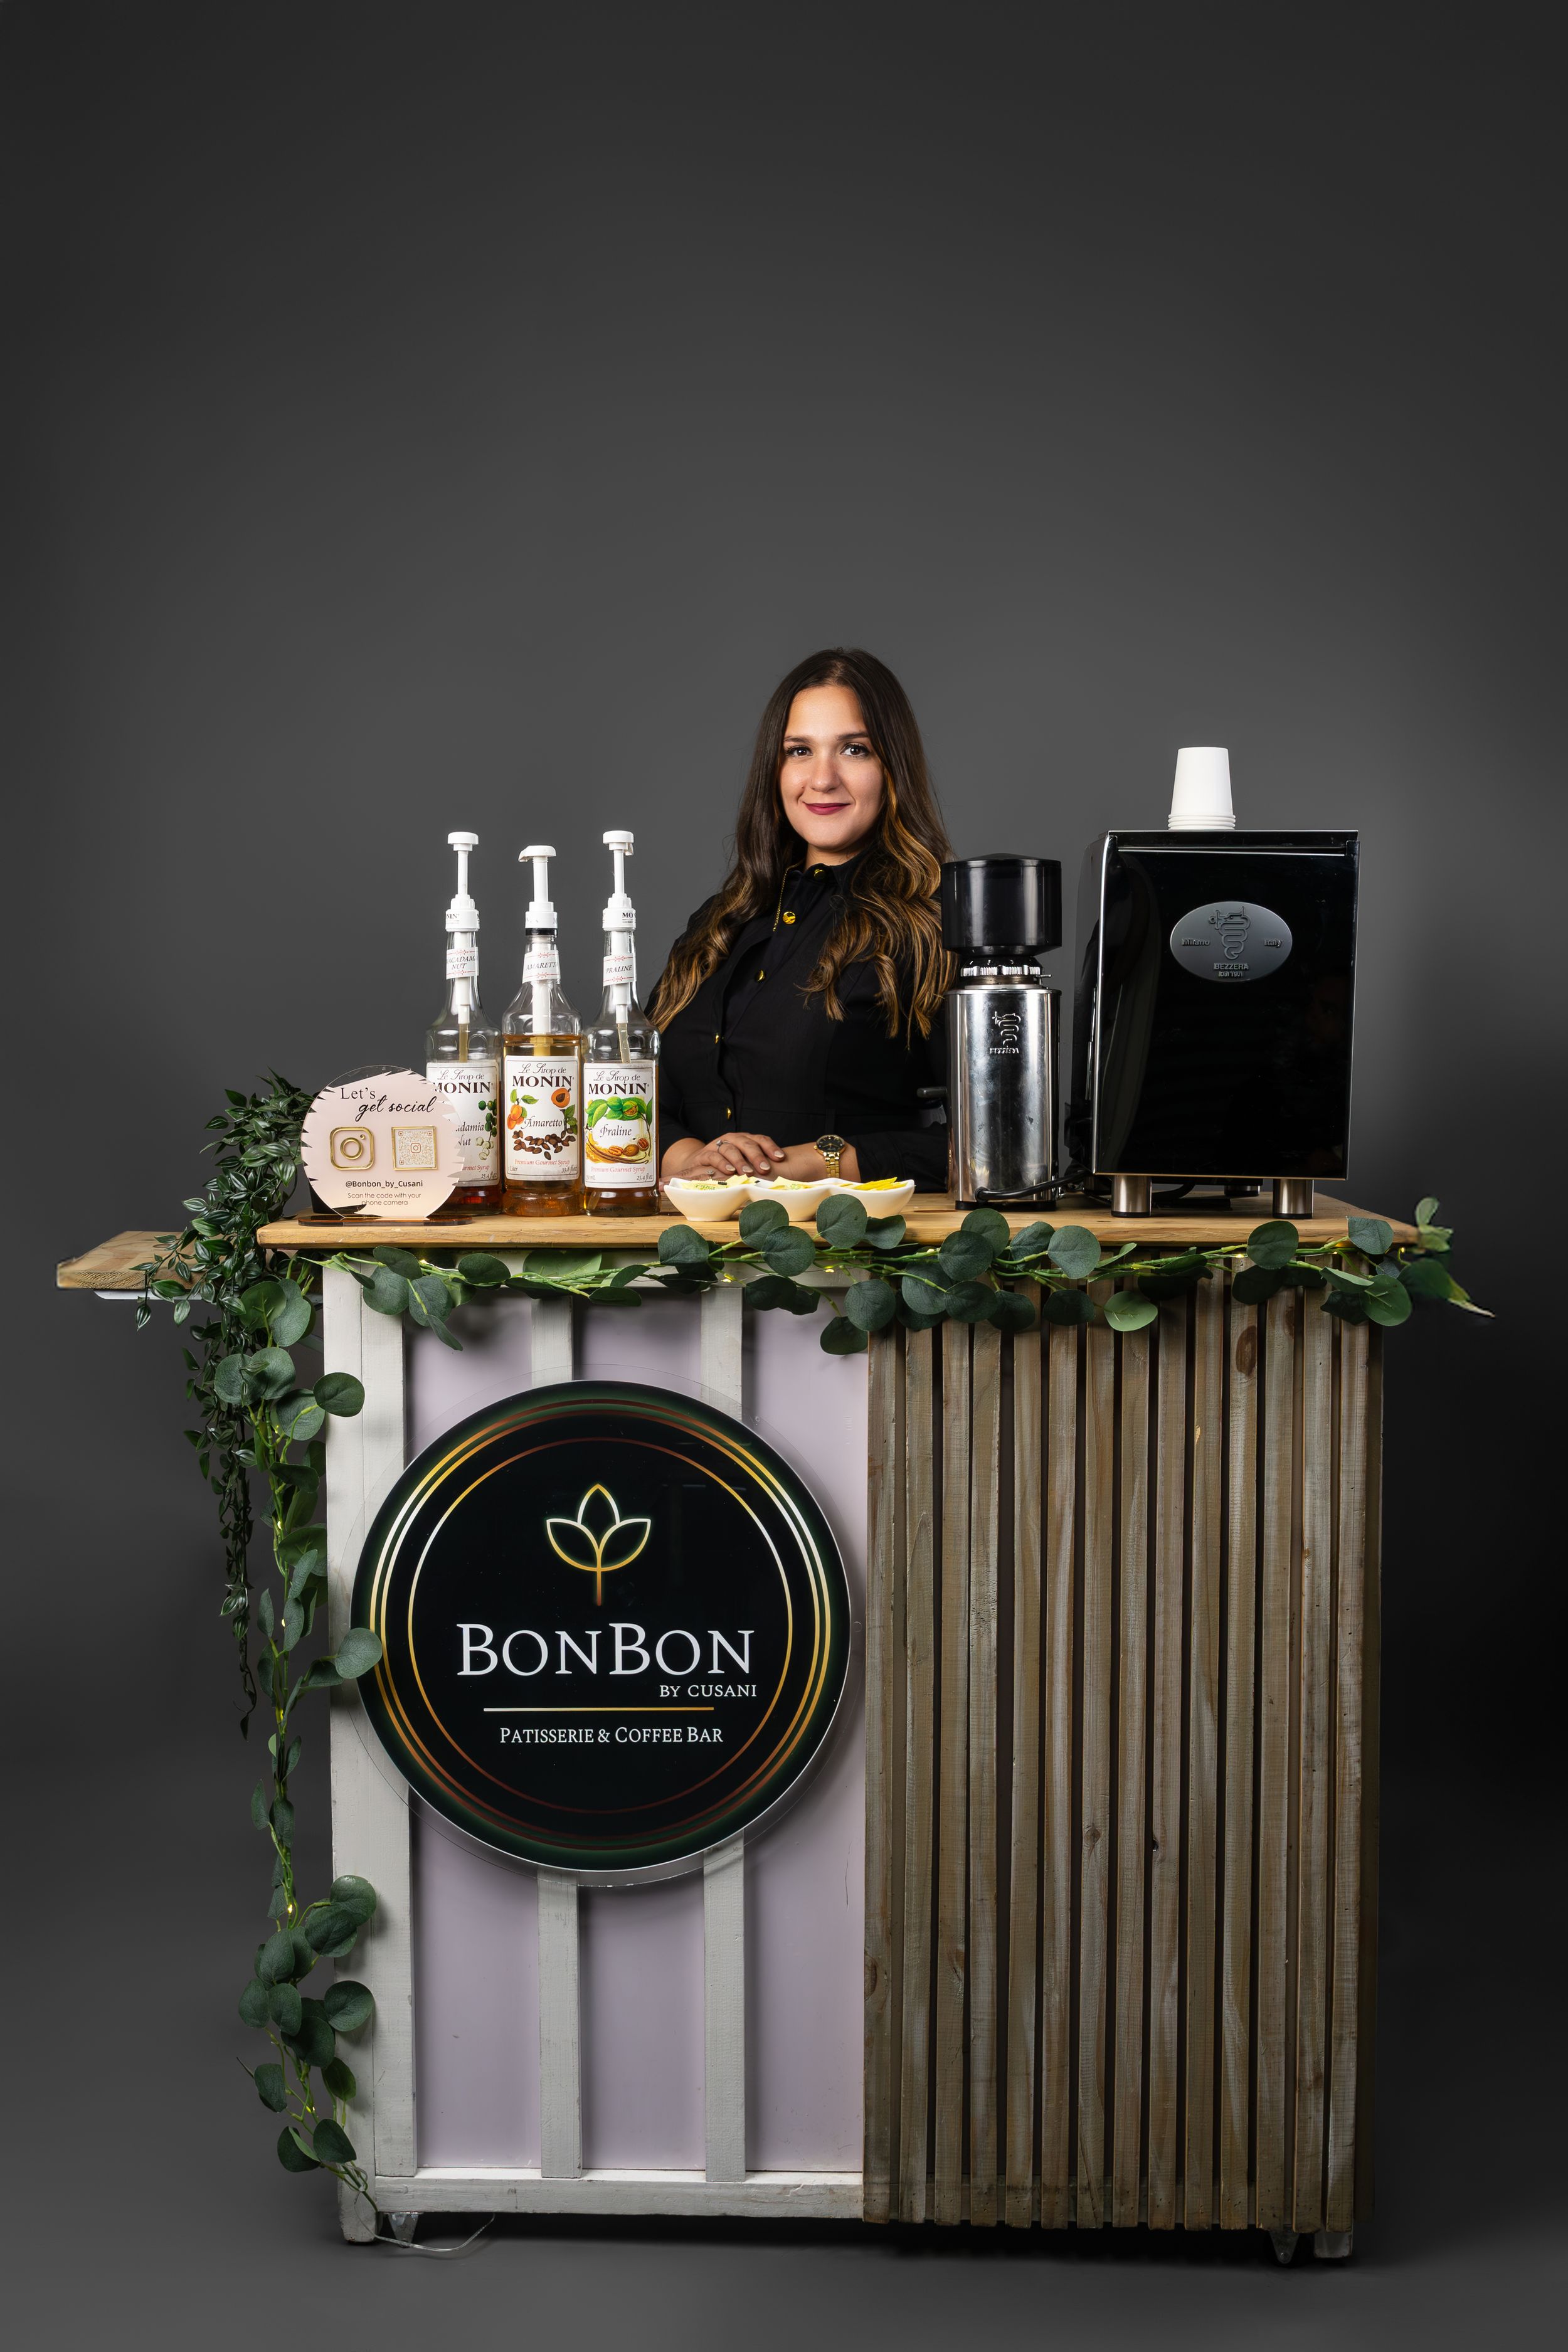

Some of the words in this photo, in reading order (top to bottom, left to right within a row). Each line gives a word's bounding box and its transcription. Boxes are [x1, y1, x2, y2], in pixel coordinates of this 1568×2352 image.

[606, 965, 632, 973] PRALINE
[512, 1076, 571, 1087] MONIN
[588, 1083, 647, 1094] MONIN
[355, 1094, 388, 1122] get
[388, 1096, 437, 1113] social
[521, 1116, 563, 1129] Amaretto
[600, 1124, 632, 1137] Praline
[477, 1165, 490, 1173] Syrup
[660, 1685, 681, 1697] BY
[687, 1685, 757, 1697] CUSANI
[598, 1729, 610, 1743] &
